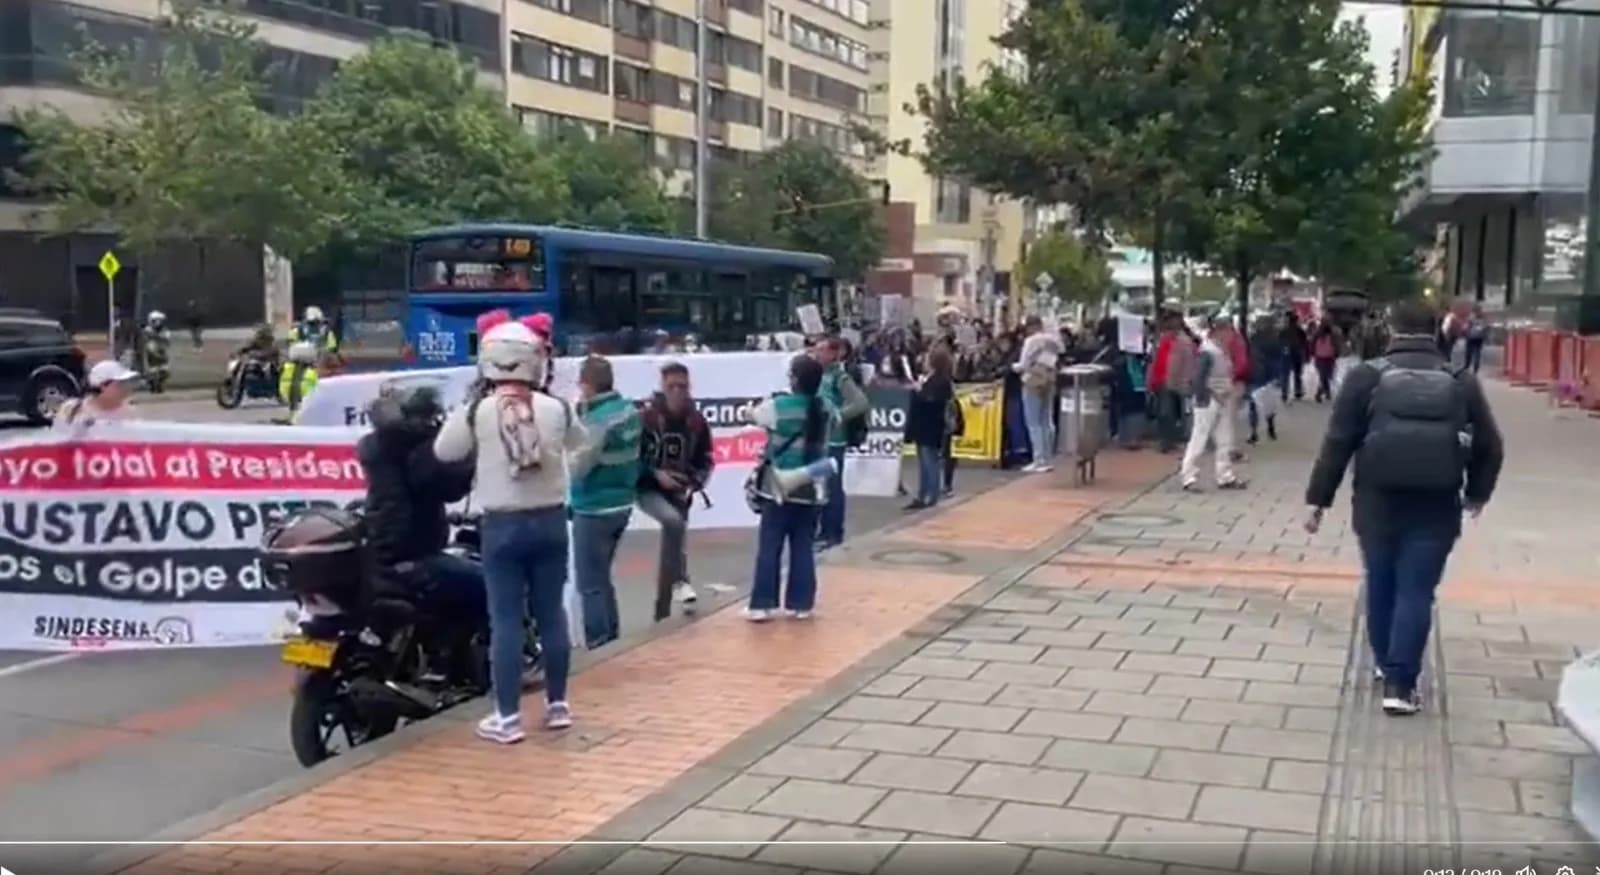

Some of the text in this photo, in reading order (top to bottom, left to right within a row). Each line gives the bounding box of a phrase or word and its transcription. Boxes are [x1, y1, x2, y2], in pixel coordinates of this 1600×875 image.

[0, 457, 58, 485] yo
[165, 448, 200, 479] al
[53, 560, 87, 587] el
[99, 559, 227, 597] Golpe
[34, 615, 150, 638] SINDESENA
